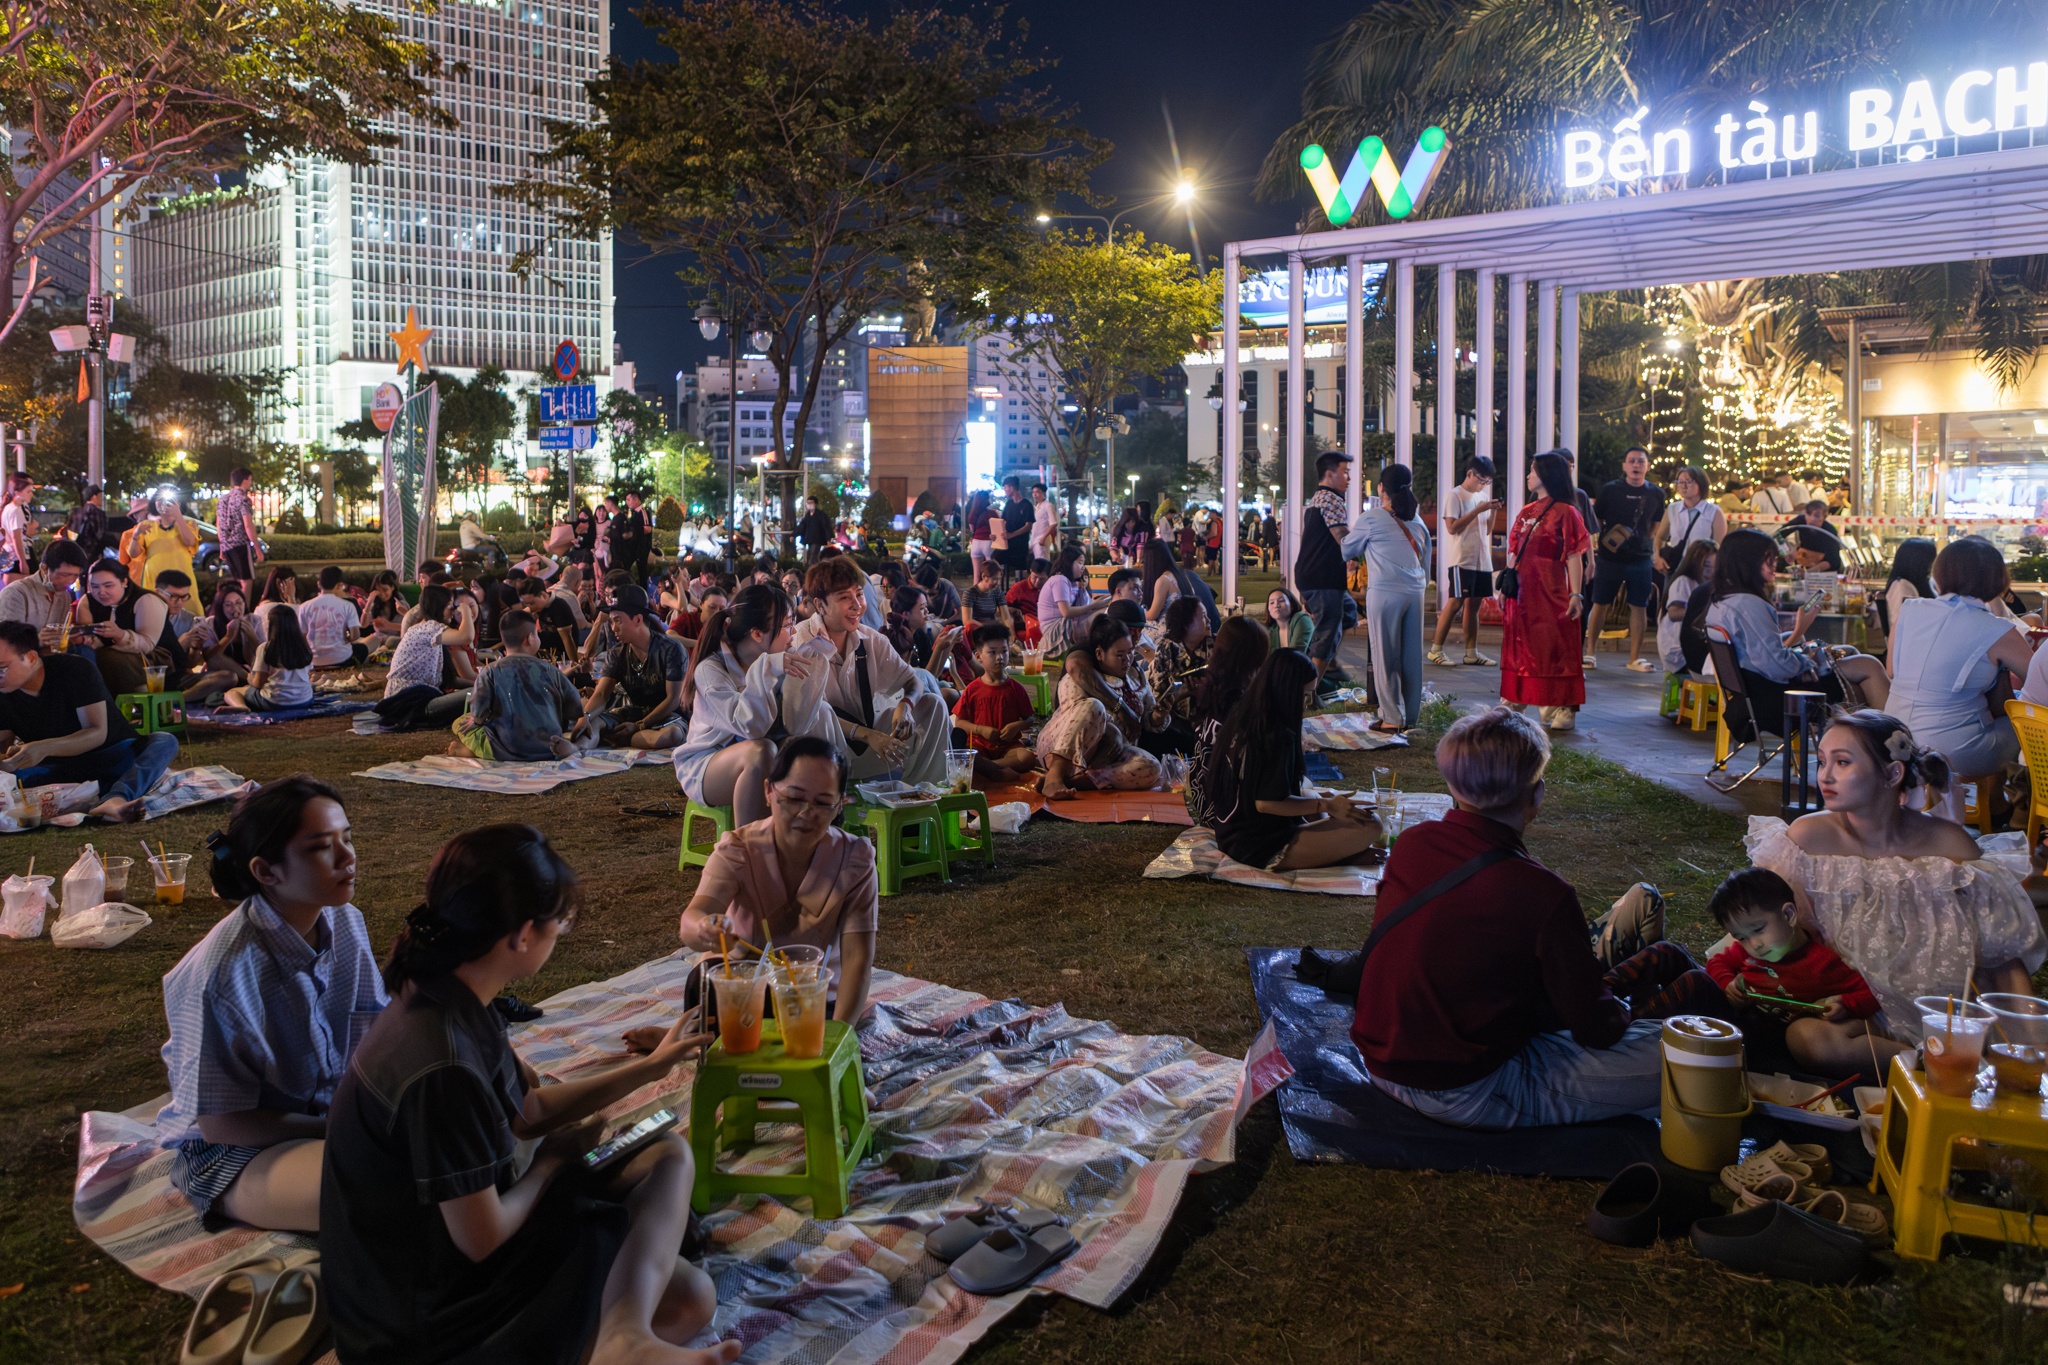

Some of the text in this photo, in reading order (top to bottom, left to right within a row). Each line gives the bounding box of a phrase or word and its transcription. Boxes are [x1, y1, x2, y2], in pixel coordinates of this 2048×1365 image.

[1565, 61, 2048, 188] Bến tàu BẠCH
[376, 399, 391, 408] Bank
